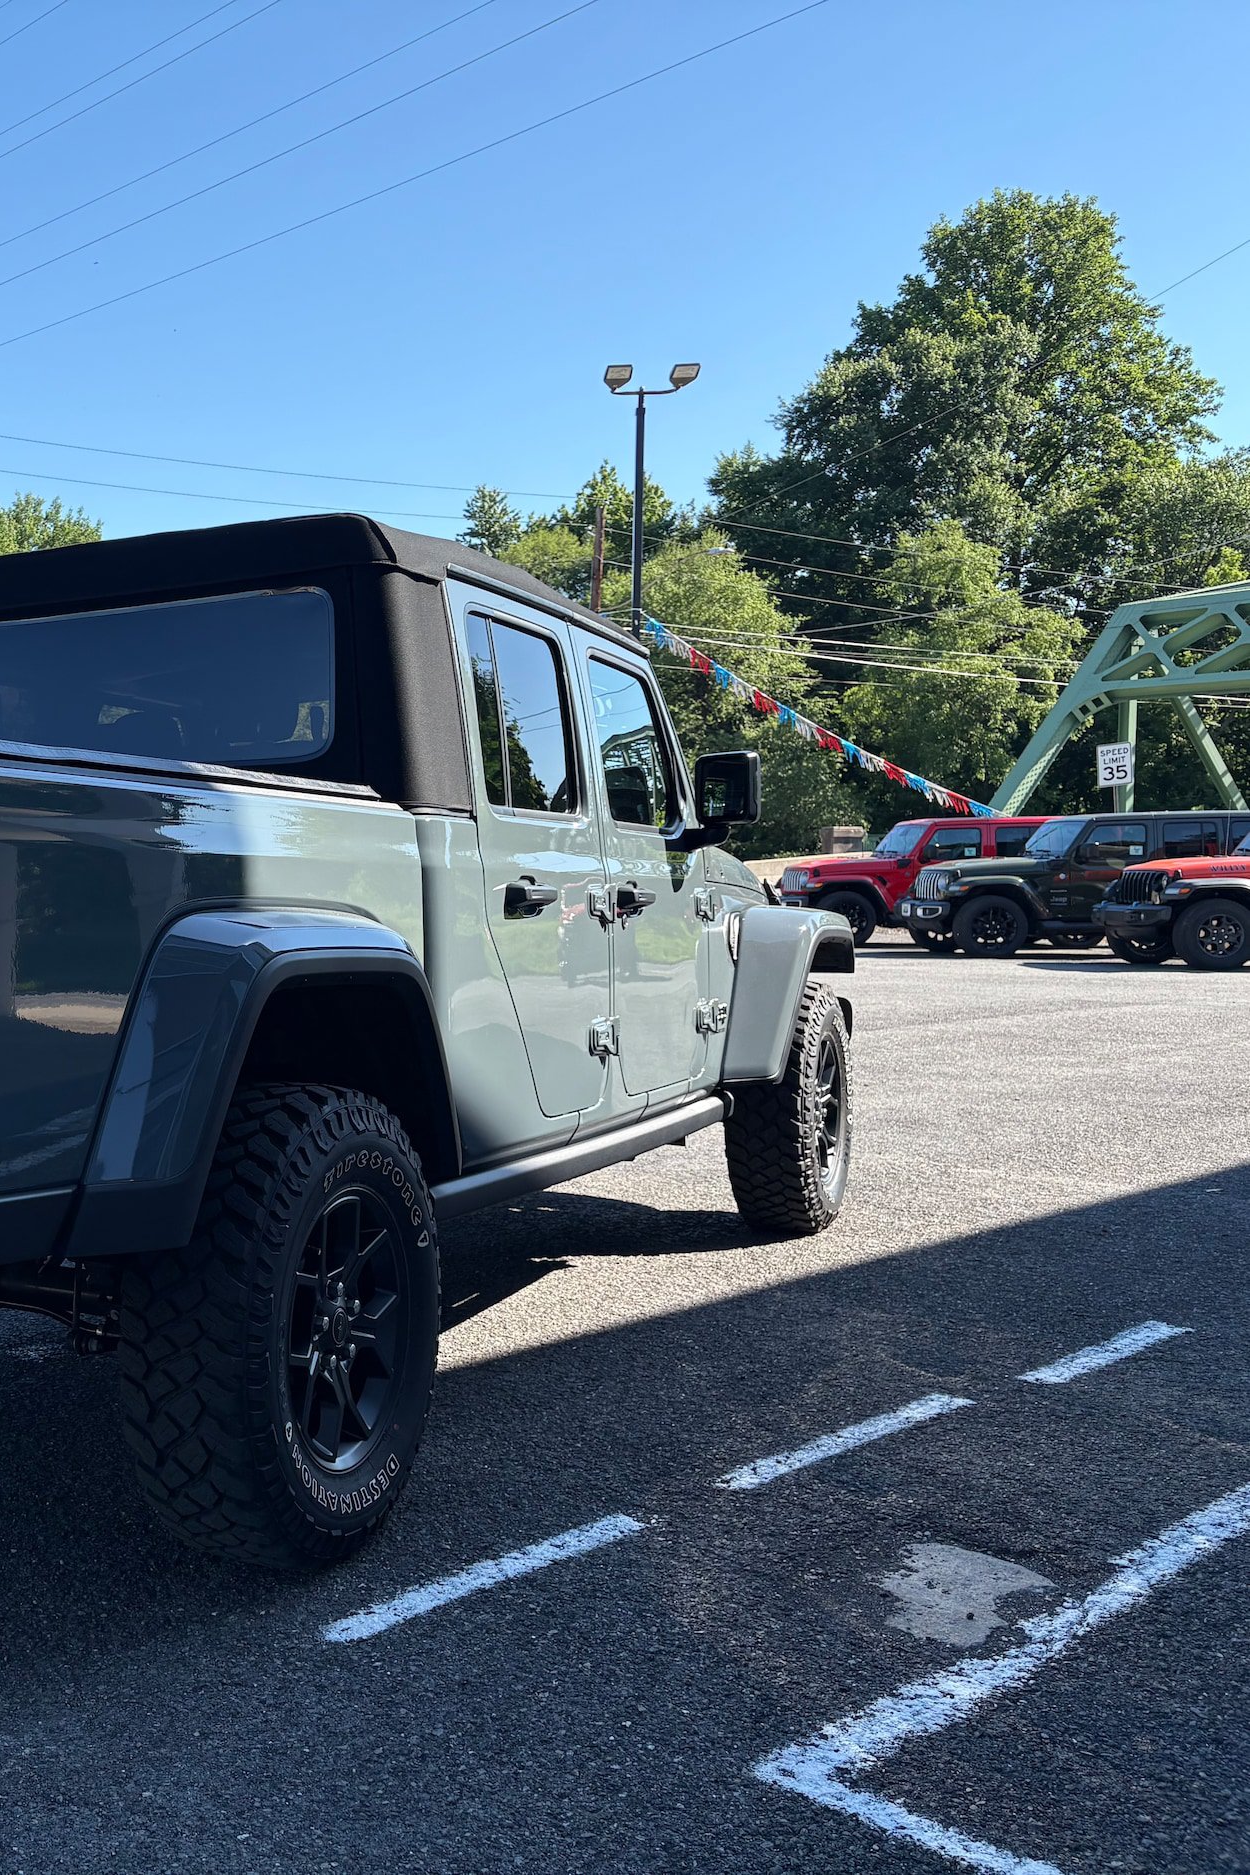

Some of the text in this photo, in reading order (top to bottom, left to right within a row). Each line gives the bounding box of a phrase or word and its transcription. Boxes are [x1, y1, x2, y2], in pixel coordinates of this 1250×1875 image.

[1100, 748, 1129, 757] SPEED
[1103, 756, 1126, 765] LIMIT
[1103, 765, 1127, 781] 35
[323, 1149, 423, 1226] Firestone
[291, 1444, 400, 1514] DESTINATION
